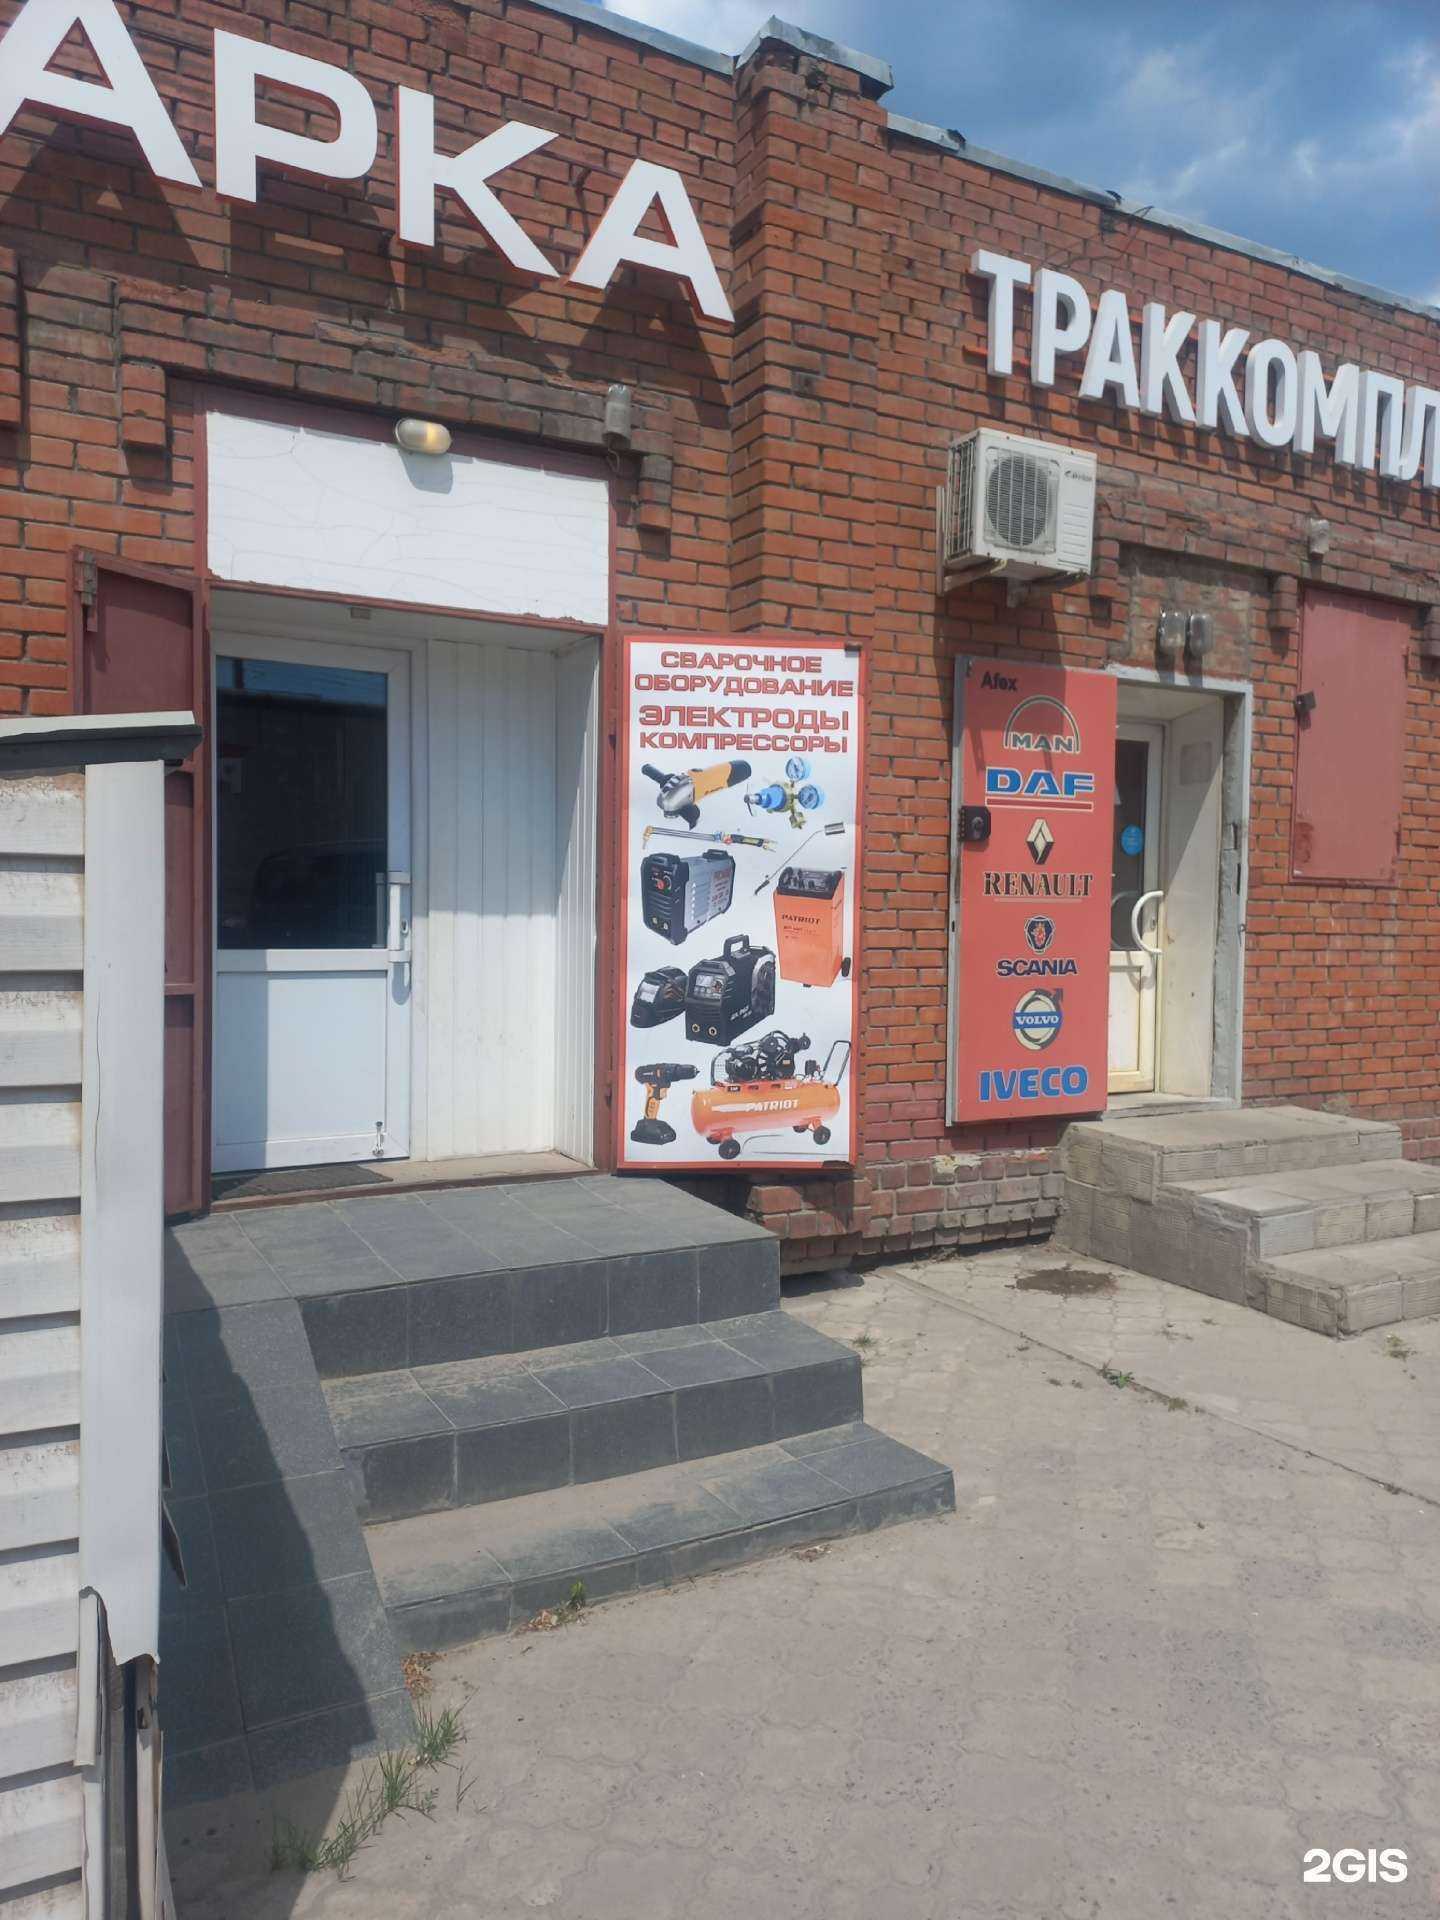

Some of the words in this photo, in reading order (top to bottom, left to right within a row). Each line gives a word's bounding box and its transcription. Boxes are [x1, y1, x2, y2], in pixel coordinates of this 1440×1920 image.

[0, 0, 735, 323] АРКА
[660, 651, 822, 673] СВАРОЧНОЕ
[634, 674, 854, 697] ОБОРУДОВАНИЕ
[639, 705, 849, 733] ЭЛЕКТРОДЫ
[640, 731, 848, 753] КОМПРЕССОРЫ
[1010, 732, 1074, 752] MAN
[985, 767, 1095, 799] DAF
[984, 872, 1093, 897] RENAULT
[997, 958, 1078, 977] SCANIA
[1015, 1015, 1060, 1025] VOLVO
[979, 1065, 1089, 1101] IVECO
[745, 1099, 799, 1112] PATRIOT
